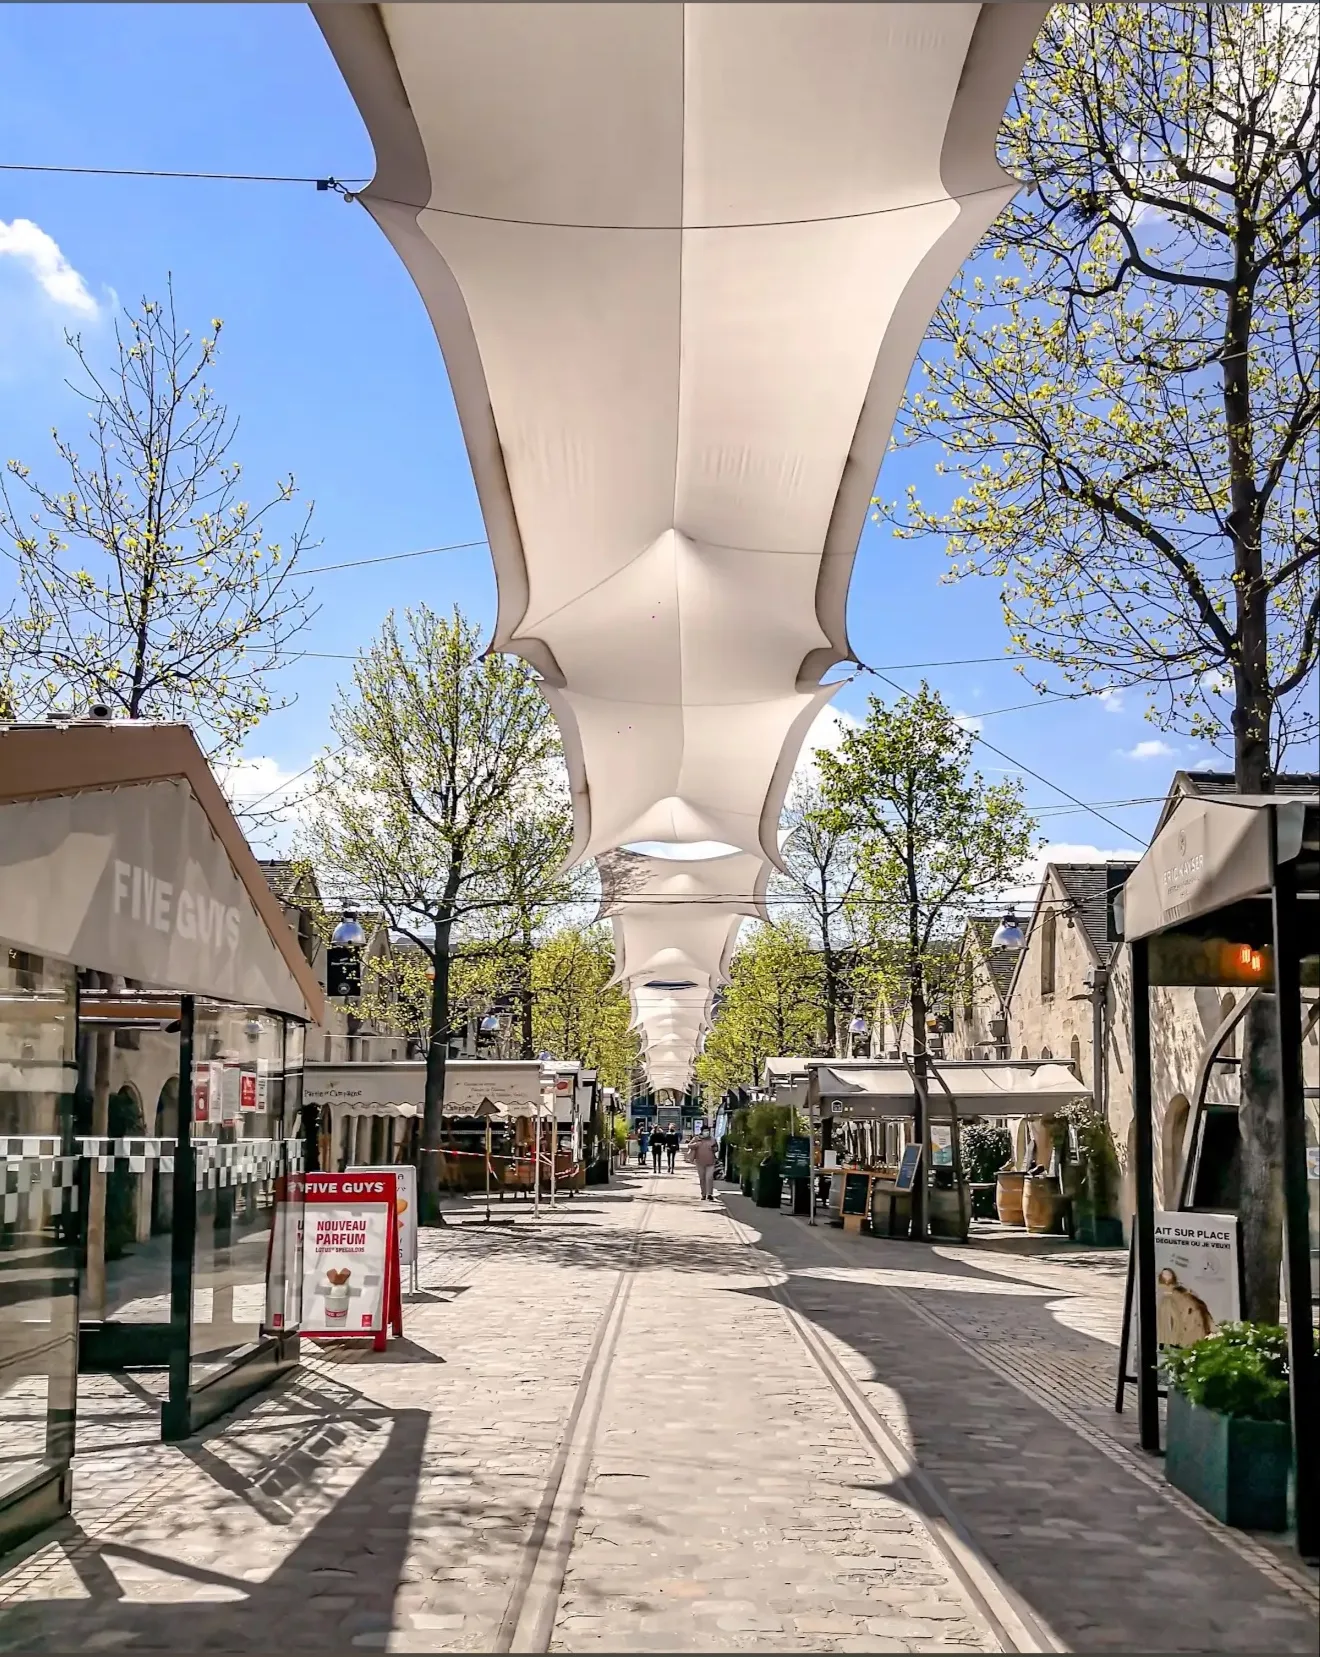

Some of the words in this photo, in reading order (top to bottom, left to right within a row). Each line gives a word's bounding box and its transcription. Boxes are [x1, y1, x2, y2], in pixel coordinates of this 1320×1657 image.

[114, 859, 173, 934] FIVE
[176, 888, 241, 952] GUYS
[305, 1183, 338, 1194] FIVE
[342, 1182, 384, 1193] GUYS
[317, 1220, 366, 1231] NOUVEAU
[316, 1233, 366, 1245] PARFUM
[1155, 1226, 1172, 1236] AIT
[1174, 1228, 1195, 1238] SUR
[1197, 1230, 1230, 1240] PLACE
